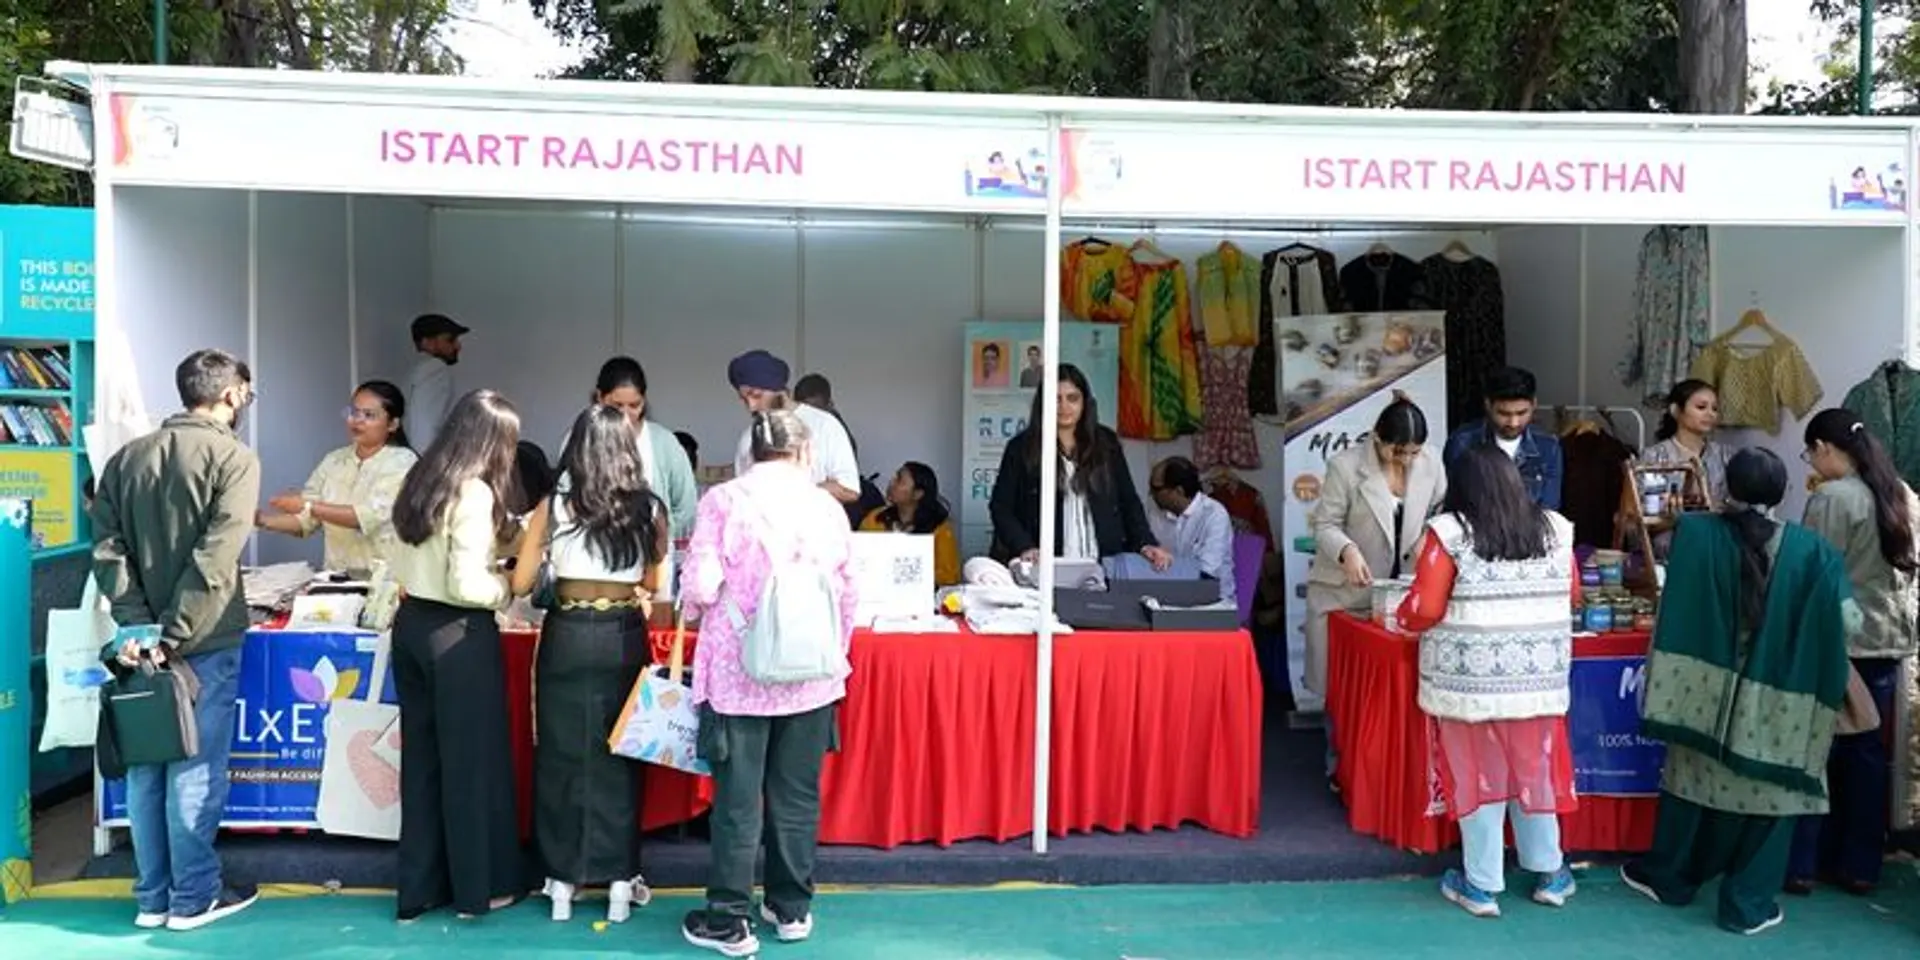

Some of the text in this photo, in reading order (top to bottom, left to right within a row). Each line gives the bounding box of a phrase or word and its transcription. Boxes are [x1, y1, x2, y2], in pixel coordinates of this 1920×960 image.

[379, 130, 804, 176] ISTART RAJASTHAN
[1302, 157, 1686, 194] ISTART RAJASTHAN
[19, 259, 59, 275] THIS
[20, 276, 92, 295] IS MADE
